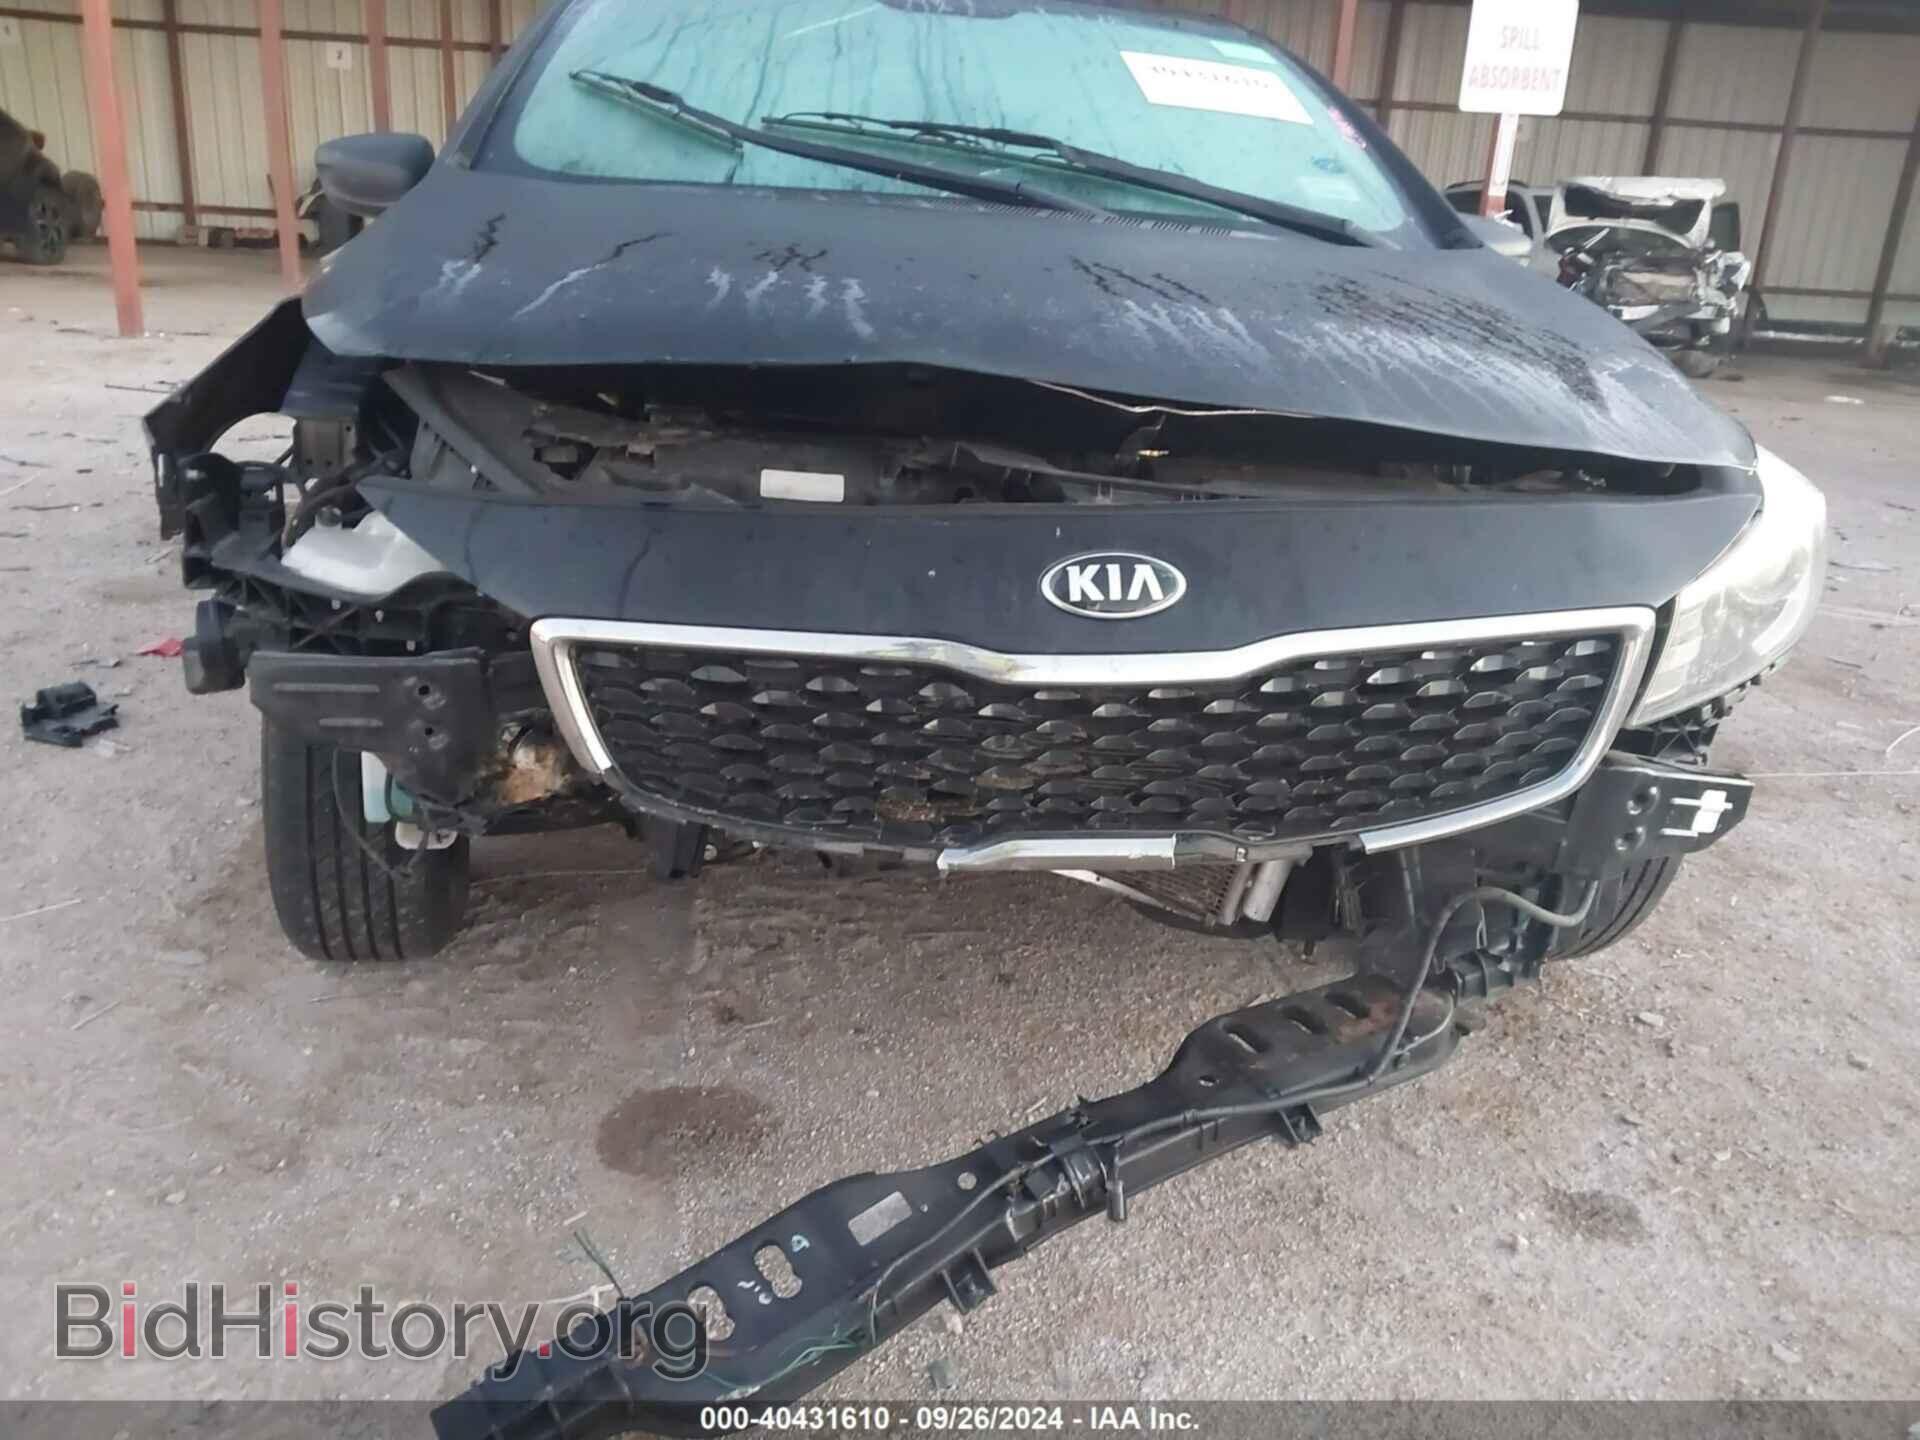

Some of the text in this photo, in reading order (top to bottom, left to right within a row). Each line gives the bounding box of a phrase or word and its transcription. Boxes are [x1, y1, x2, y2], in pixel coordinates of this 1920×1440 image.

[1499, 25, 1541, 50] SPILL
[1468, 64, 1561, 91] ABSORBENT
[1065, 563, 1164, 602] KIA
